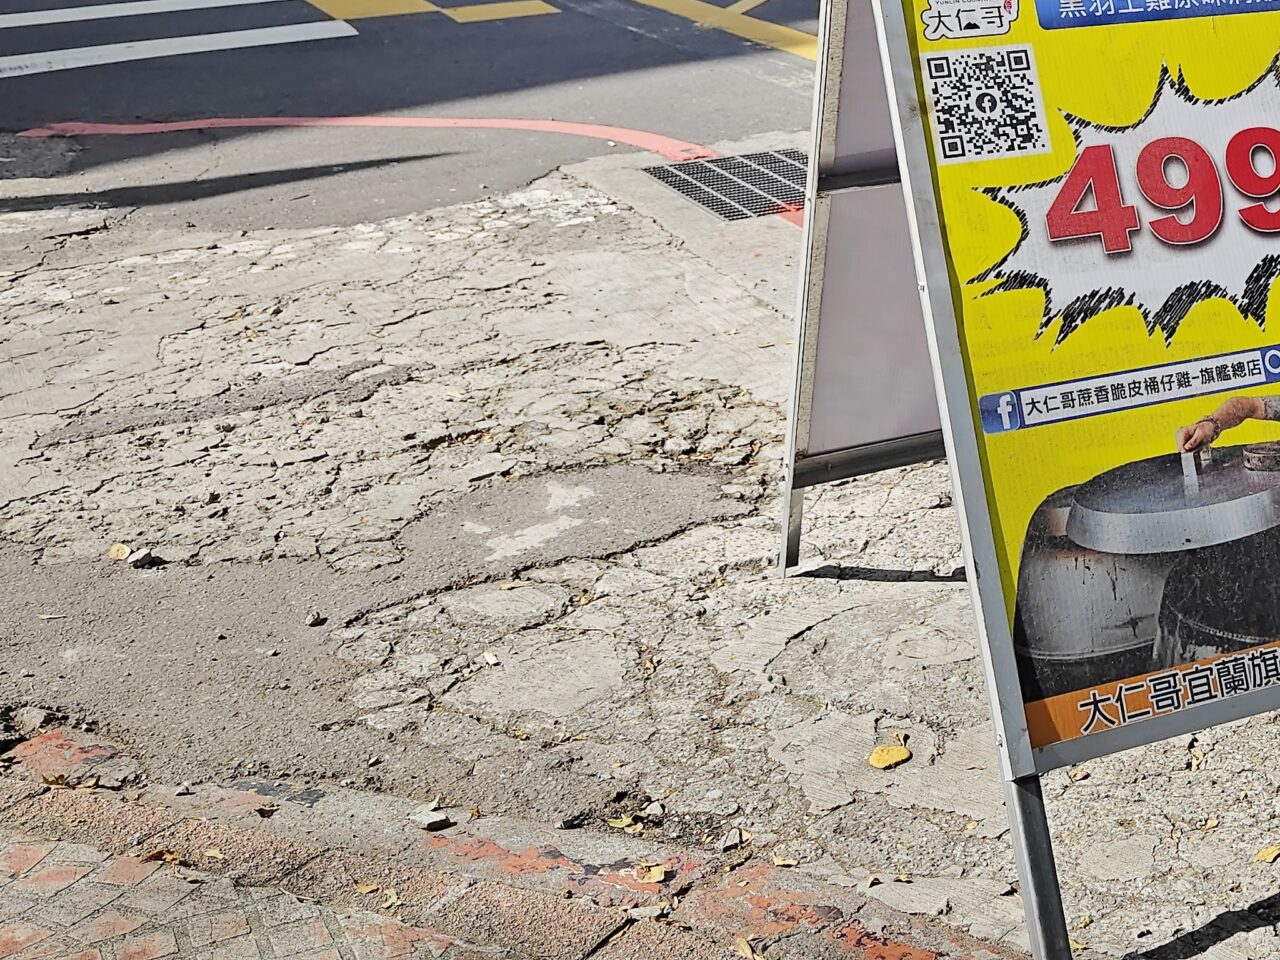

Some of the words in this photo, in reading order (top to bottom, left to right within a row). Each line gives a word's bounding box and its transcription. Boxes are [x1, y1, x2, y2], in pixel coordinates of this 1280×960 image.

[928, 5, 1004, 33] 大仁哥
[1025, 358, 1262, 417] 大仁哥蔗香脆皮桶仔雞-旗艦總店
